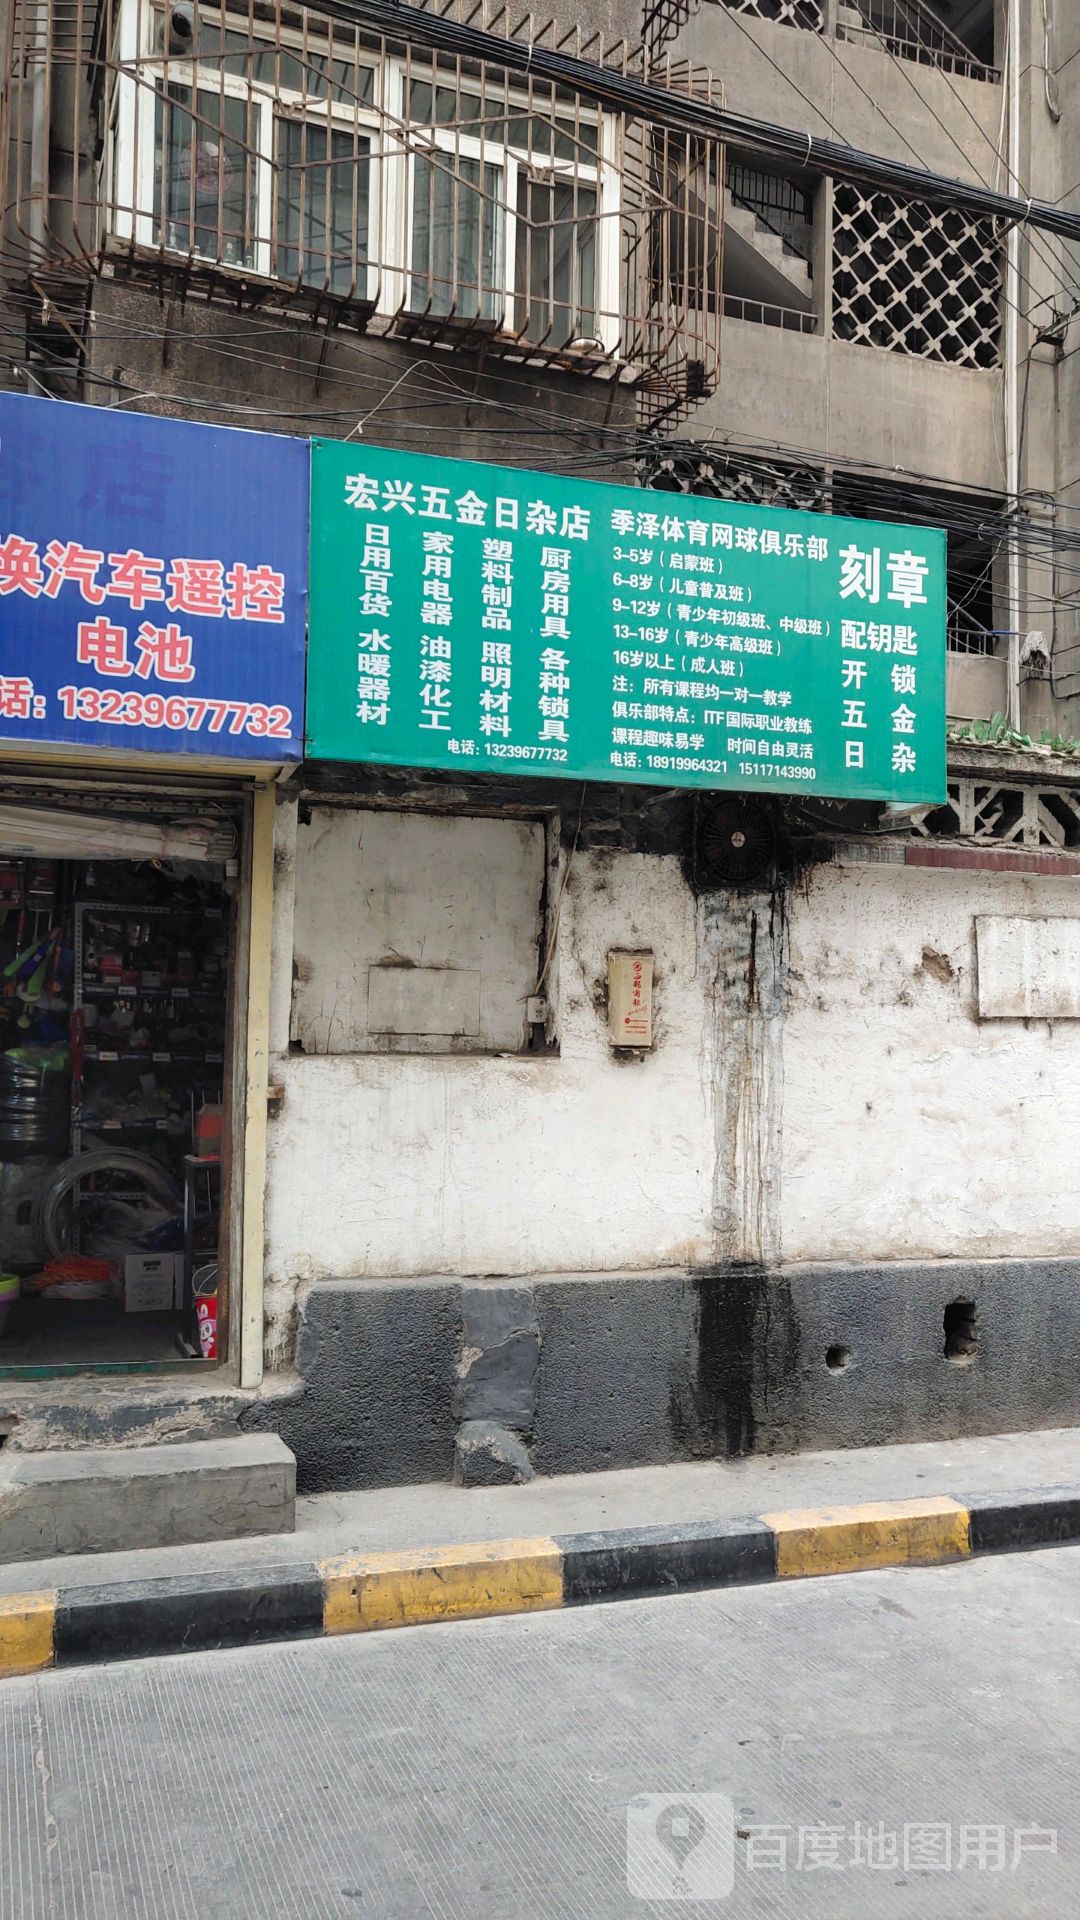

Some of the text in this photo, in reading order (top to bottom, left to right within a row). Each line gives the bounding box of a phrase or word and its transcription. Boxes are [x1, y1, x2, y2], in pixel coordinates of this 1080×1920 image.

[344, 474, 591, 541] 宏兴五金日杂店
[610, 508, 829, 562] 季泽体育网球俱乐部
[0, 534, 285, 623] 换汽车遥控
[838, 544, 930, 609] 刻章
[77, 616, 195, 683] 电池
[355, 523, 394, 726] 日用百货 水暖器材
[418, 531, 454, 731] 家用电器 油漆化工
[479, 538, 514, 738] 塑料制品 照明材料
[538, 546, 572, 743] 厨房用具 各种锁具
[841, 619, 918, 656] 配钥匙
[611, 727, 814, 760] 课程趣味易学 时间自由灵活
[738, 762, 816, 780] 15117143990
